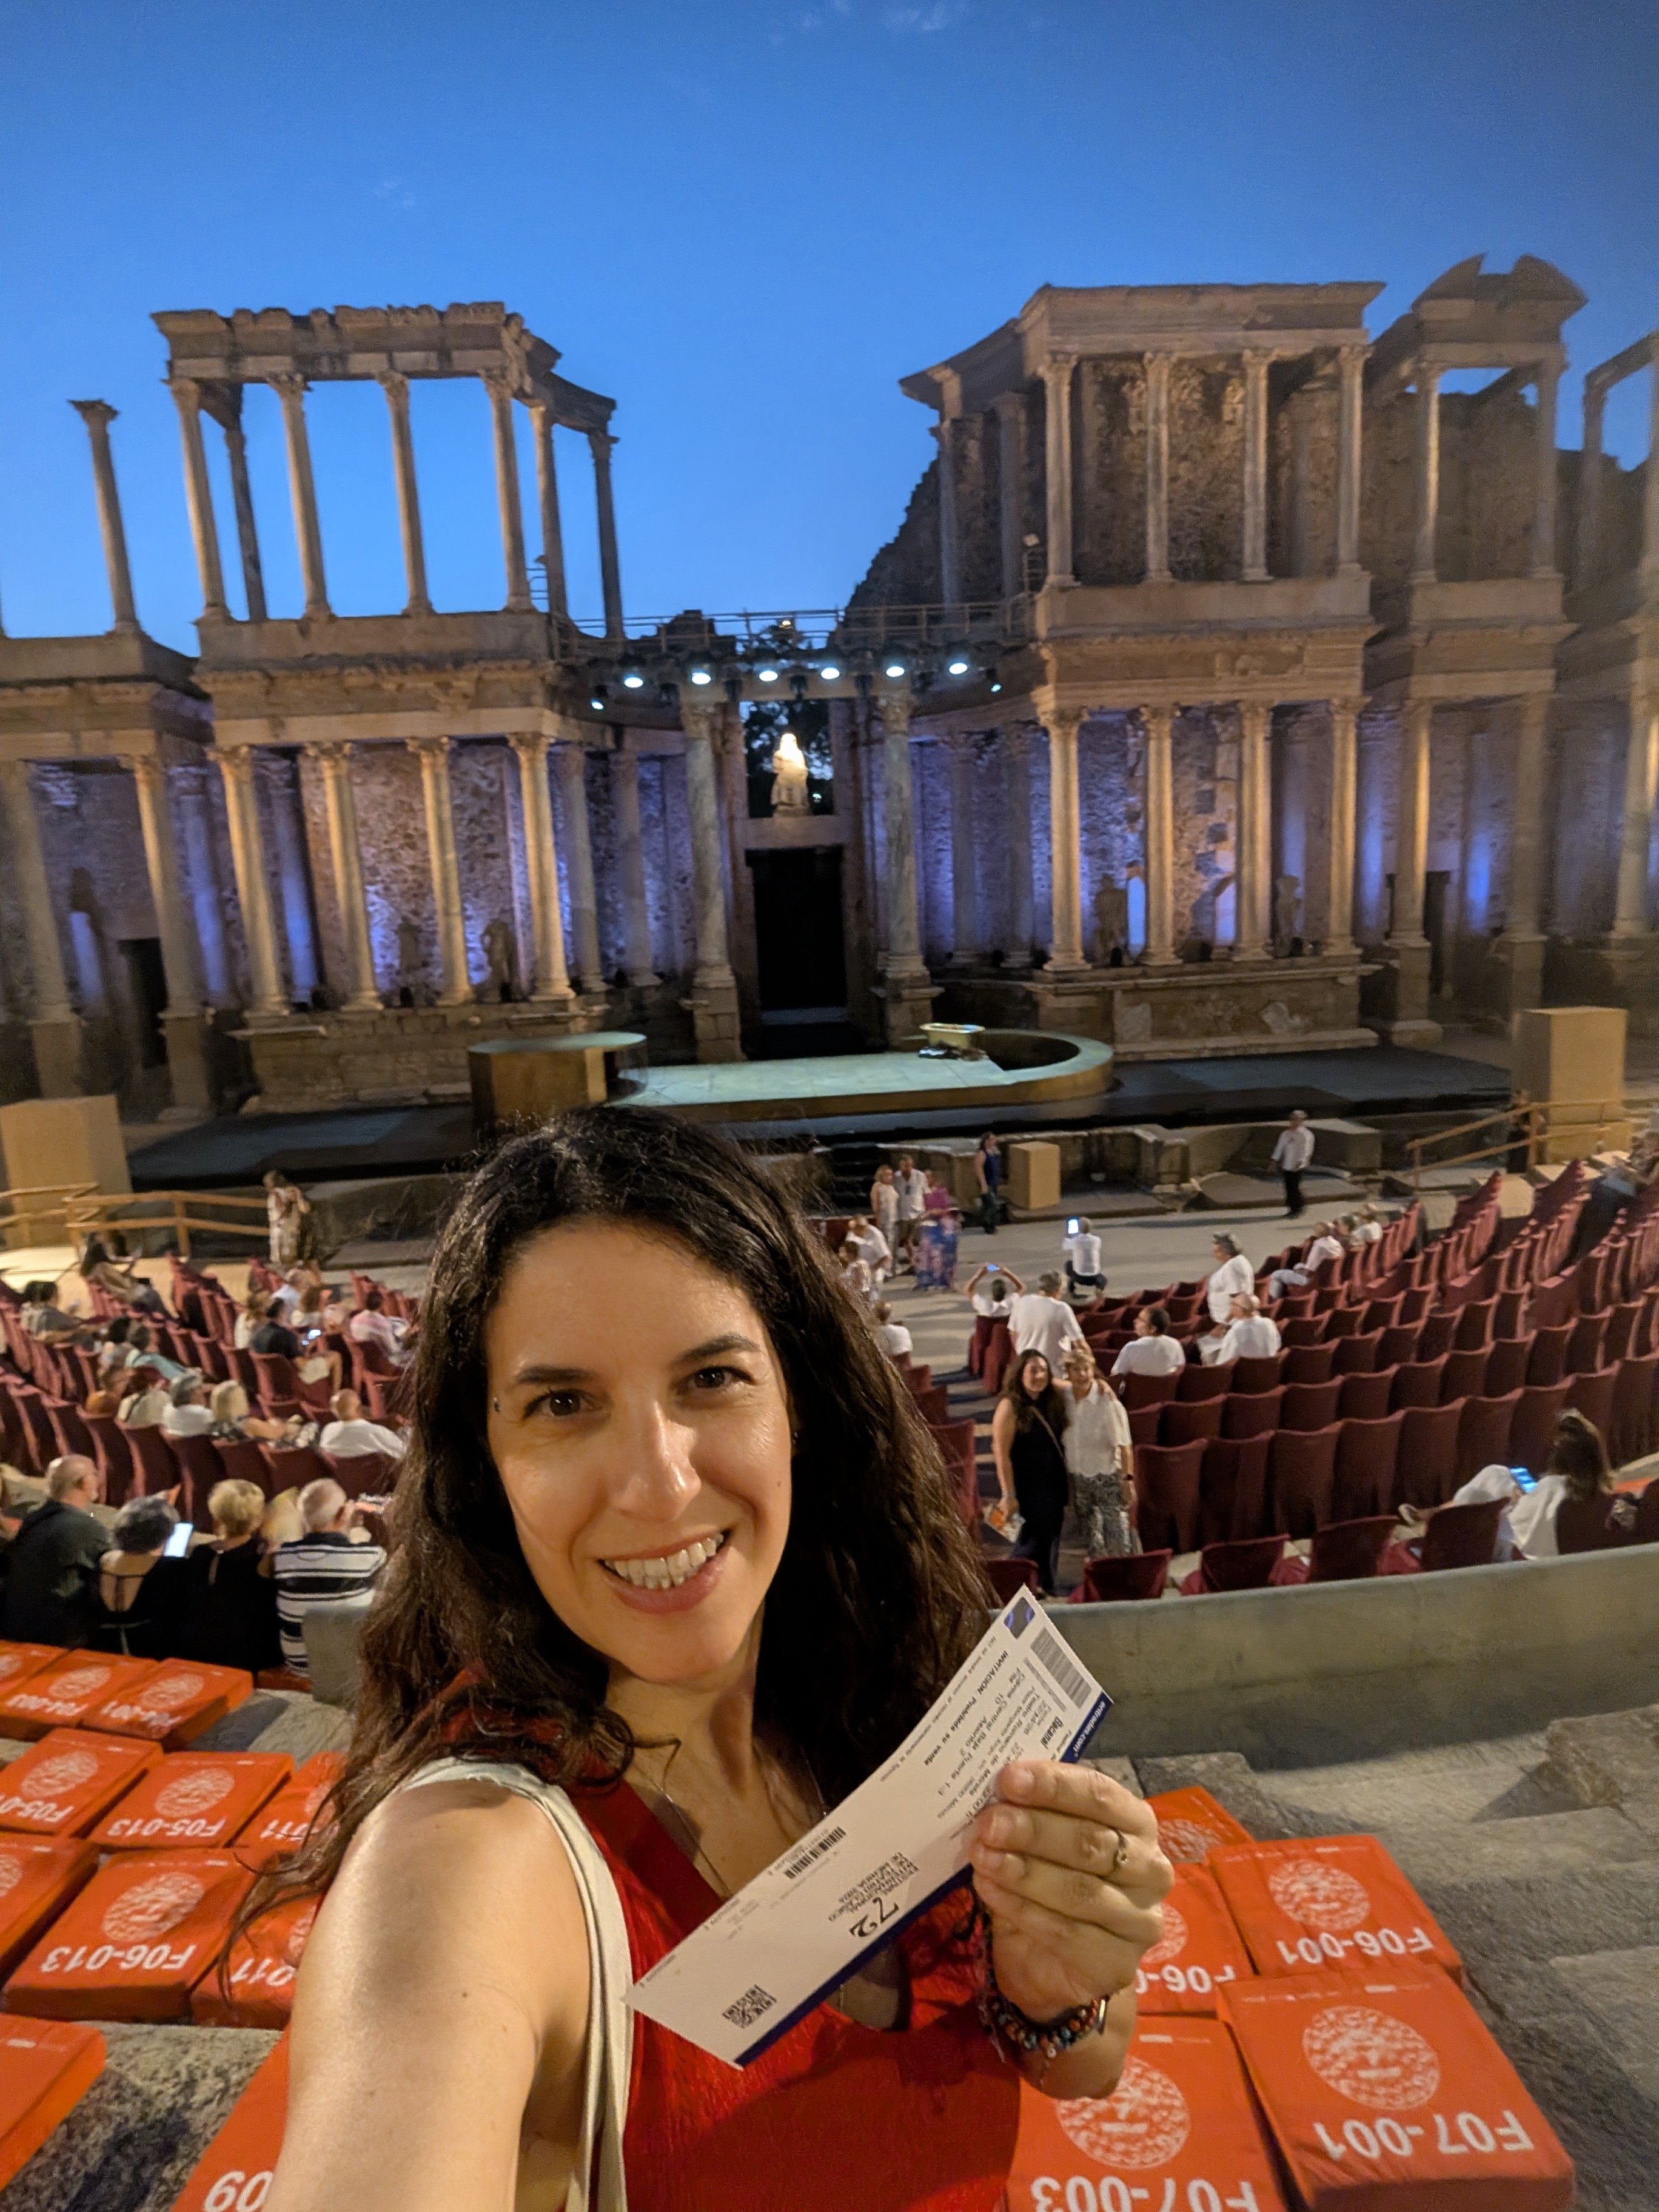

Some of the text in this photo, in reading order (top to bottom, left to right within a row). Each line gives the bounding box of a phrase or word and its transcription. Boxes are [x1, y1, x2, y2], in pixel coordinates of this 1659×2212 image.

[1040, 1715, 1064, 1750] Bacanal
[107, 1819, 223, 1838] F05-013
[848, 1895, 900, 1940] 72
[42, 1945, 195, 1972] F06-013
[1276, 1926, 1433, 1965] F06-001
[1313, 2110, 1532, 2159] F07-001
